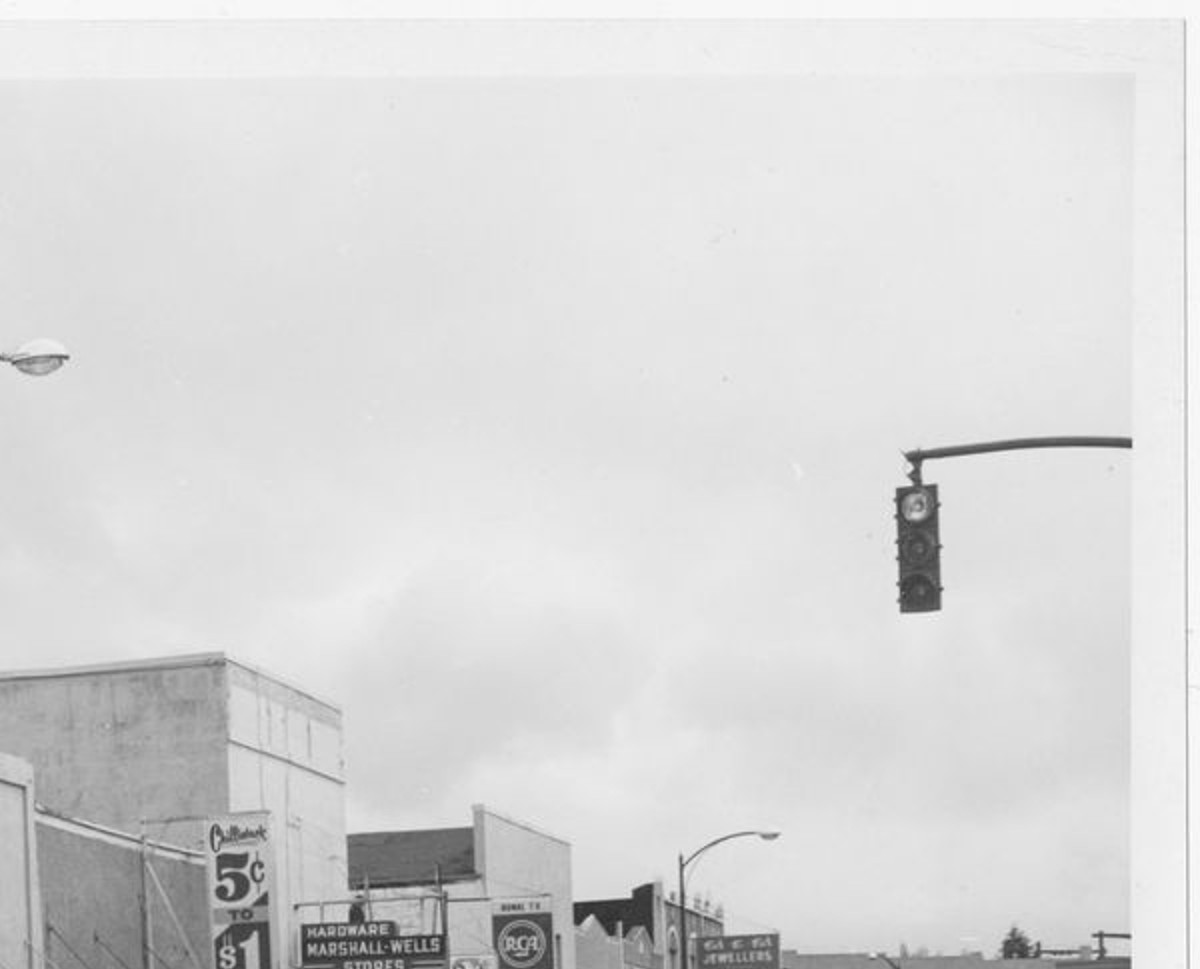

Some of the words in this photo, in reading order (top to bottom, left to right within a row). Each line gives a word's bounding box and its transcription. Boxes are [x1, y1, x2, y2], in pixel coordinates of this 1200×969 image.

[227, 909, 254, 921] TO
[307, 923, 391, 938] HARDWARE
[502, 935, 538, 957] RCA
[703, 951, 774, 965] JEWELLERS
